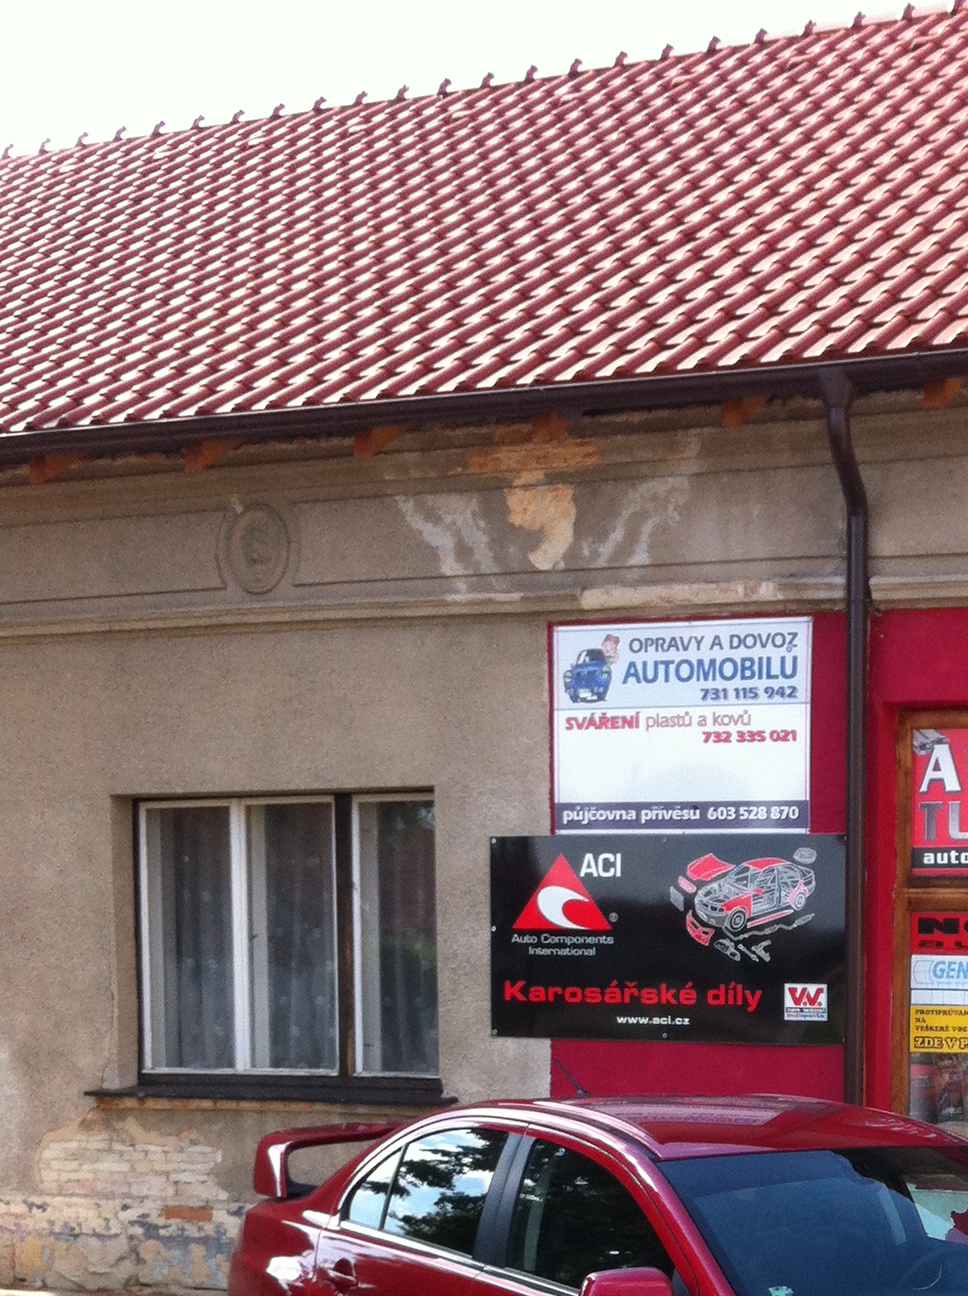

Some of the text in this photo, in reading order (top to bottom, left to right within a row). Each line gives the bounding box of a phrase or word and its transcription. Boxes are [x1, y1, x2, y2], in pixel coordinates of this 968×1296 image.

[629, 632, 798, 654] OPRAVY A DOVOZ
[622, 646, 798, 684] AUTOMOBILŮ
[700, 686, 798, 701] 731 115 942
[565, 710, 751, 732] SVÁŘENÍ plastů a kovů
[702, 730, 797, 744] 732 335 021
[562, 805, 799, 824] půjčovna přívěsů 603 528 870
[580, 853, 621, 878] ACI
[511, 933, 614, 947] Auto Components
[529, 946, 596, 957] International
[503, 980, 762, 1012] Karosářské díly
[616, 1014, 691, 1025] www.aci.cz
[914, 1036, 944, 1049] ZDE
